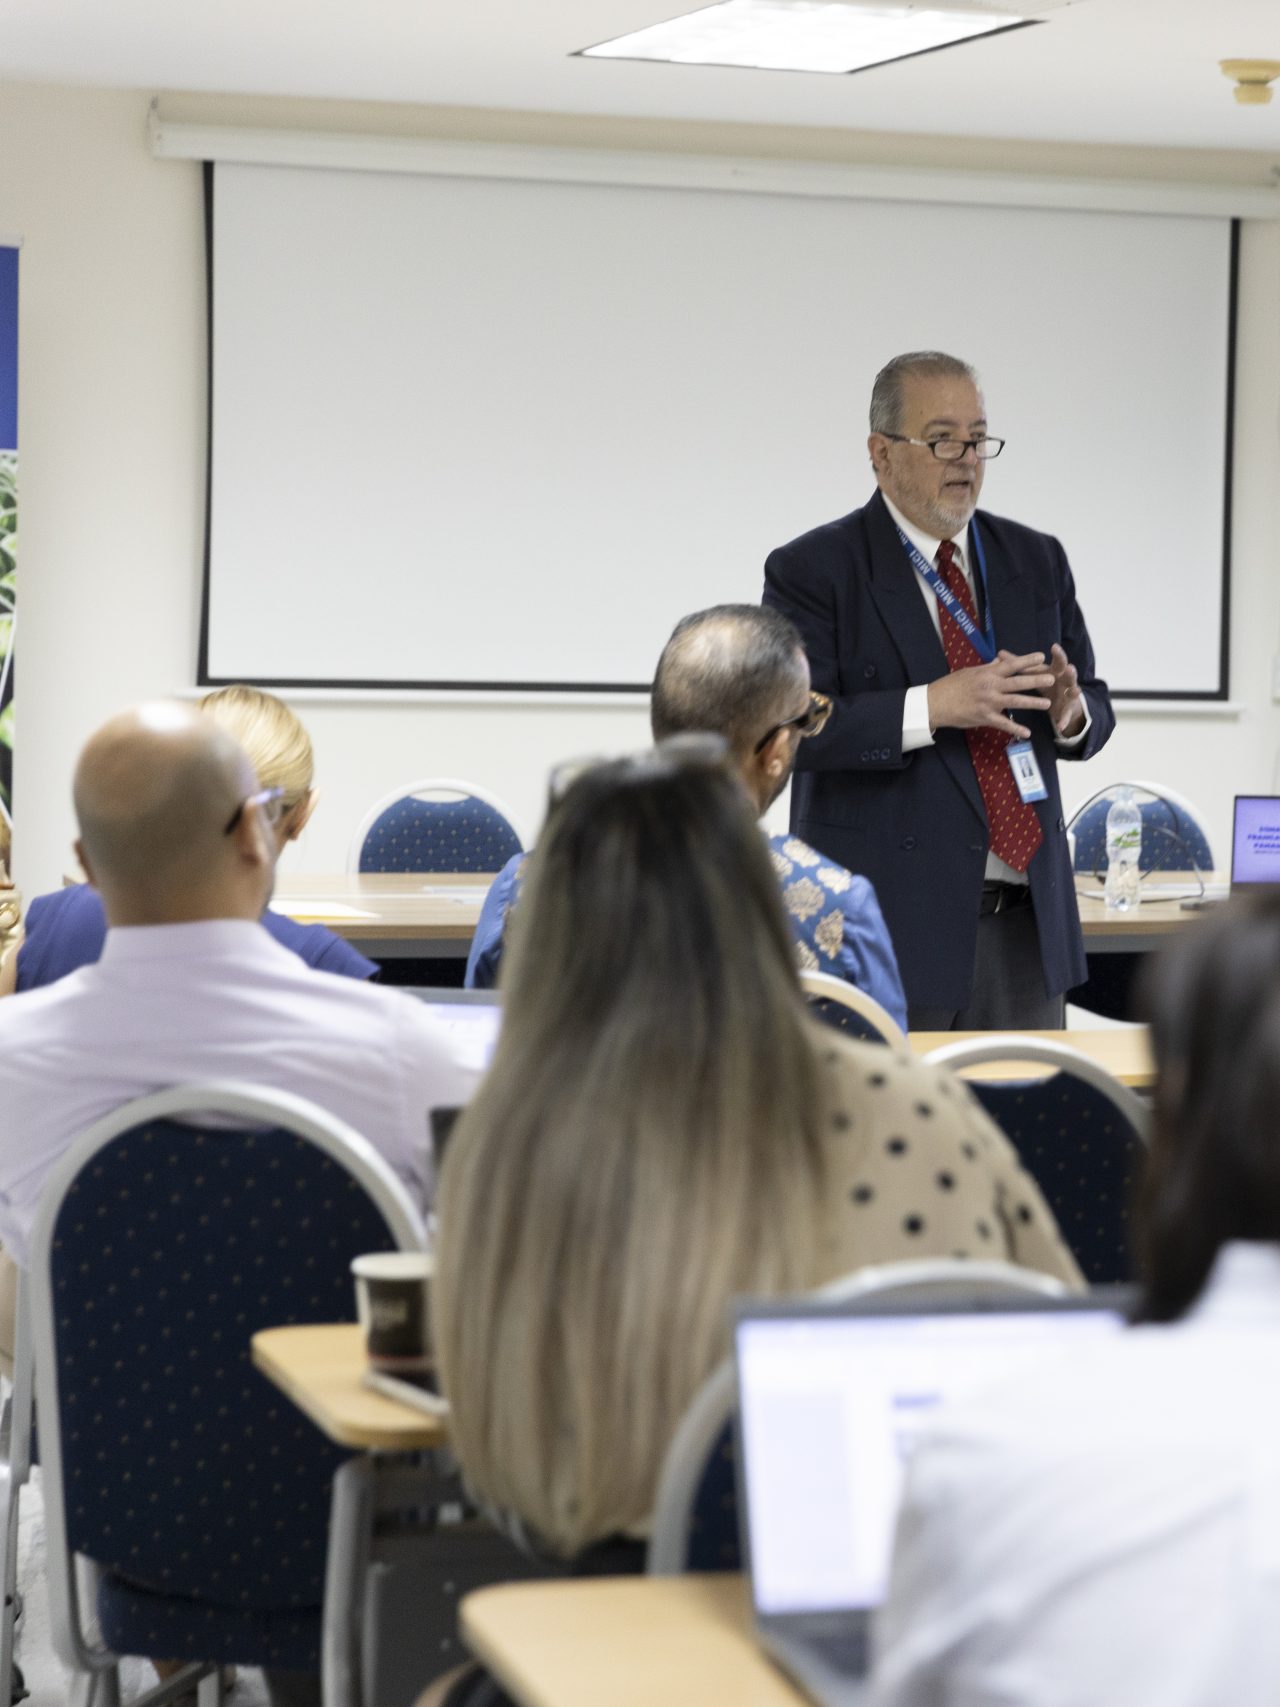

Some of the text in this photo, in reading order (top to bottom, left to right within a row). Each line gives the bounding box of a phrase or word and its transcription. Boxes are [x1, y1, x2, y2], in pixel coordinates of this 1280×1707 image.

[909, 549, 932, 576] MICI
[933, 579, 956, 606] MICI
[954, 607, 976, 635] MICI
